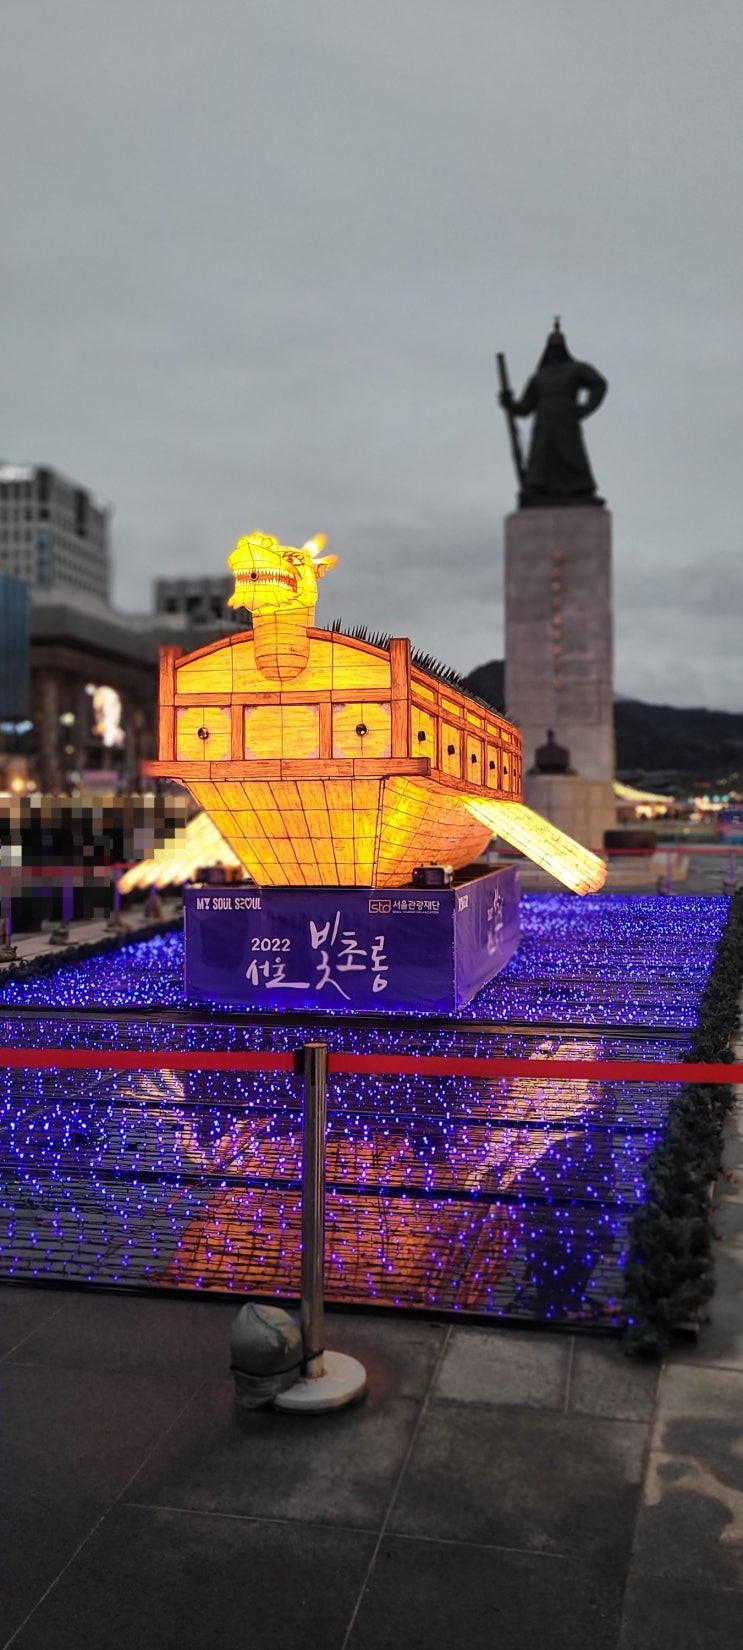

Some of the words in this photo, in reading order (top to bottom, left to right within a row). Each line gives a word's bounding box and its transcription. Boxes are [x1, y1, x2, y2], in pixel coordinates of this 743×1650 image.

[392, 899, 441, 911] 서울관광재단
[251, 937, 291, 952] 2022
[246, 957, 310, 990] 서울
[309, 910, 389, 1001] 빛초롱
